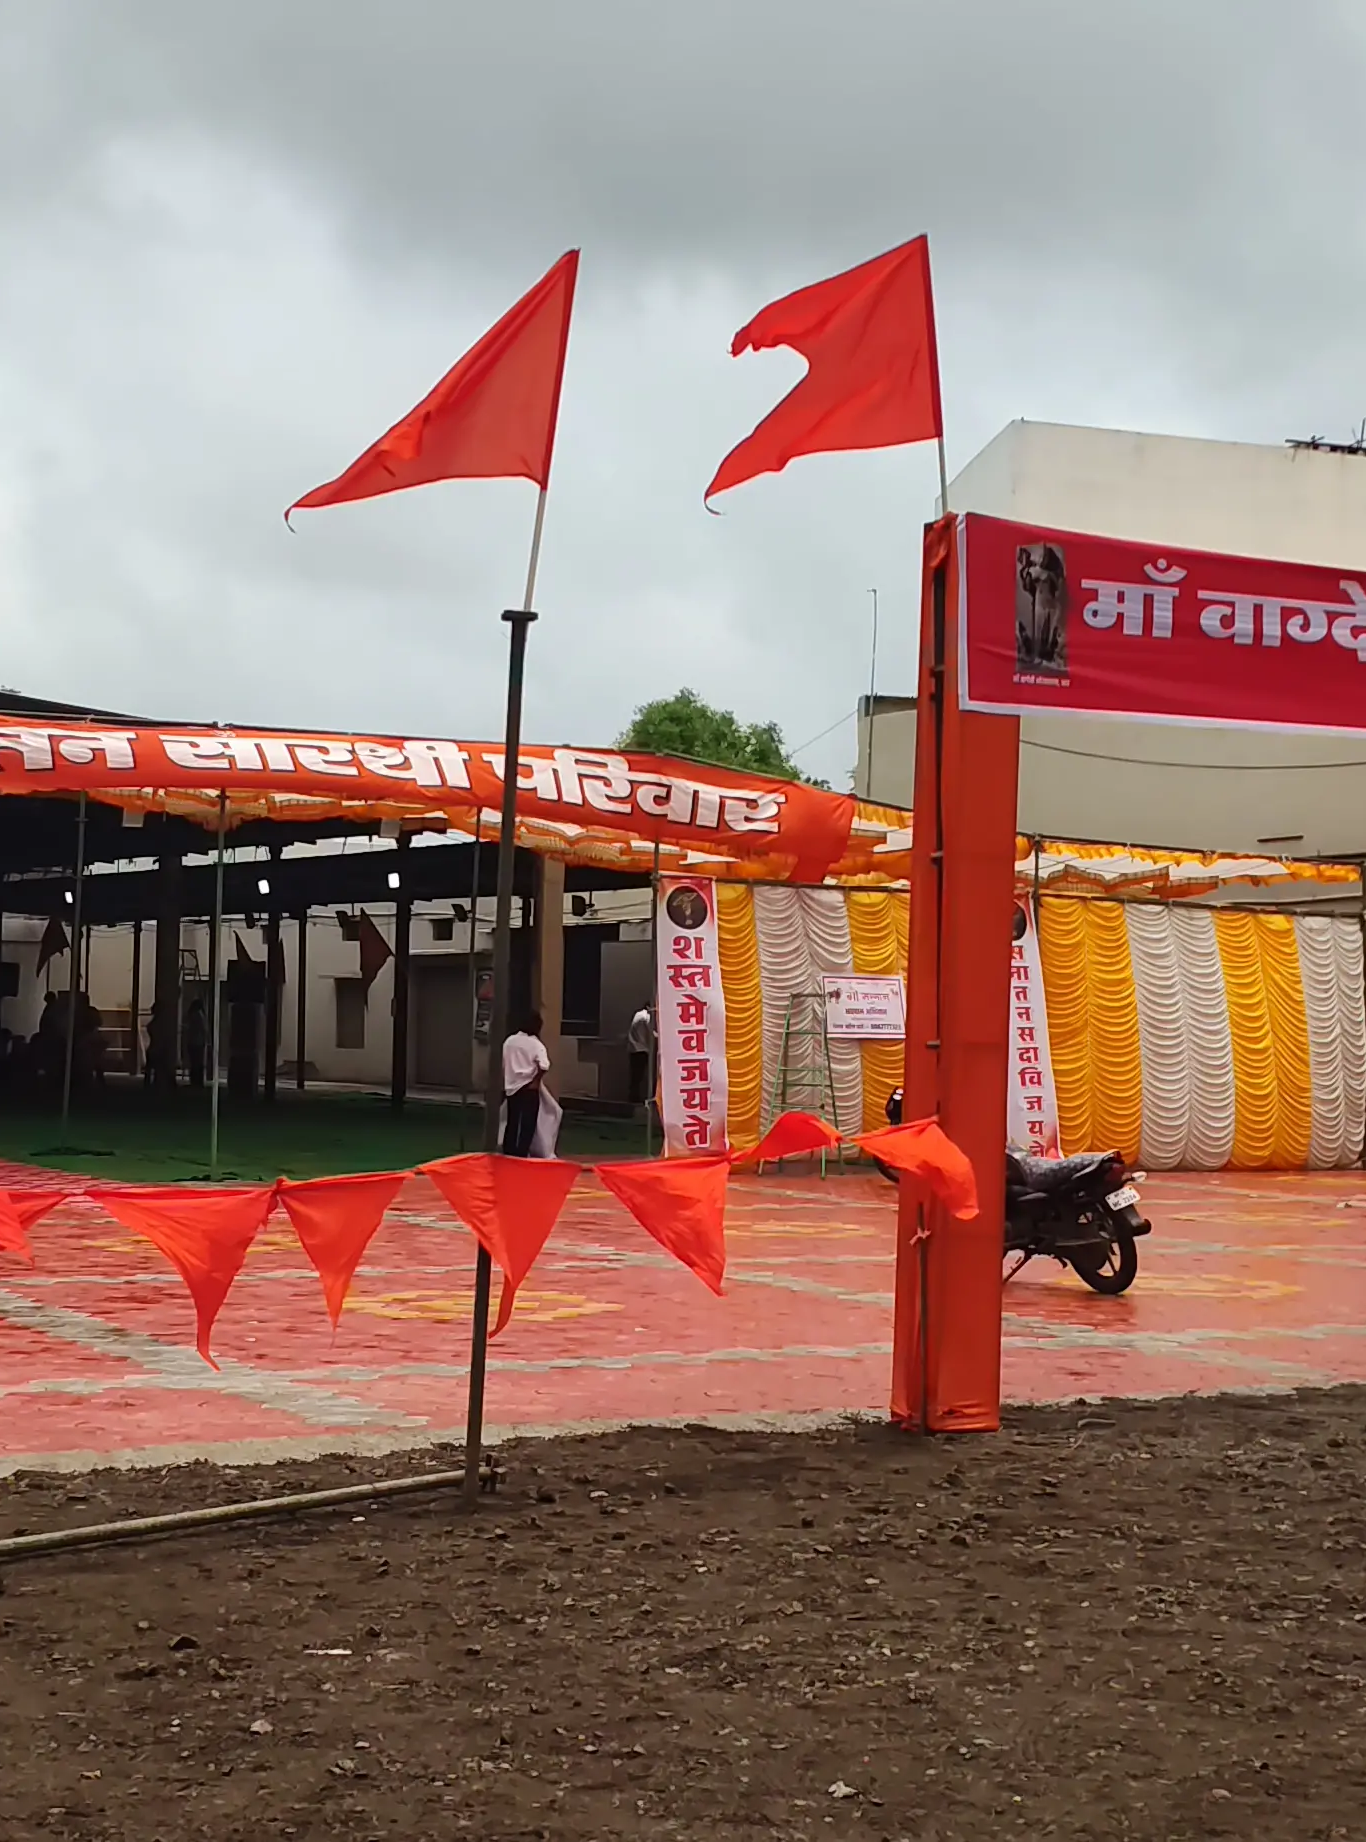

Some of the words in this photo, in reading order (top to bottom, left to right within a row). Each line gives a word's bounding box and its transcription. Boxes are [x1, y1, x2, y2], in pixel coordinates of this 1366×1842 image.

[1081, 558, 1188, 638] माँ
[158, 733, 473, 789] सारथी
[480, 747, 787, 834] परिवार
